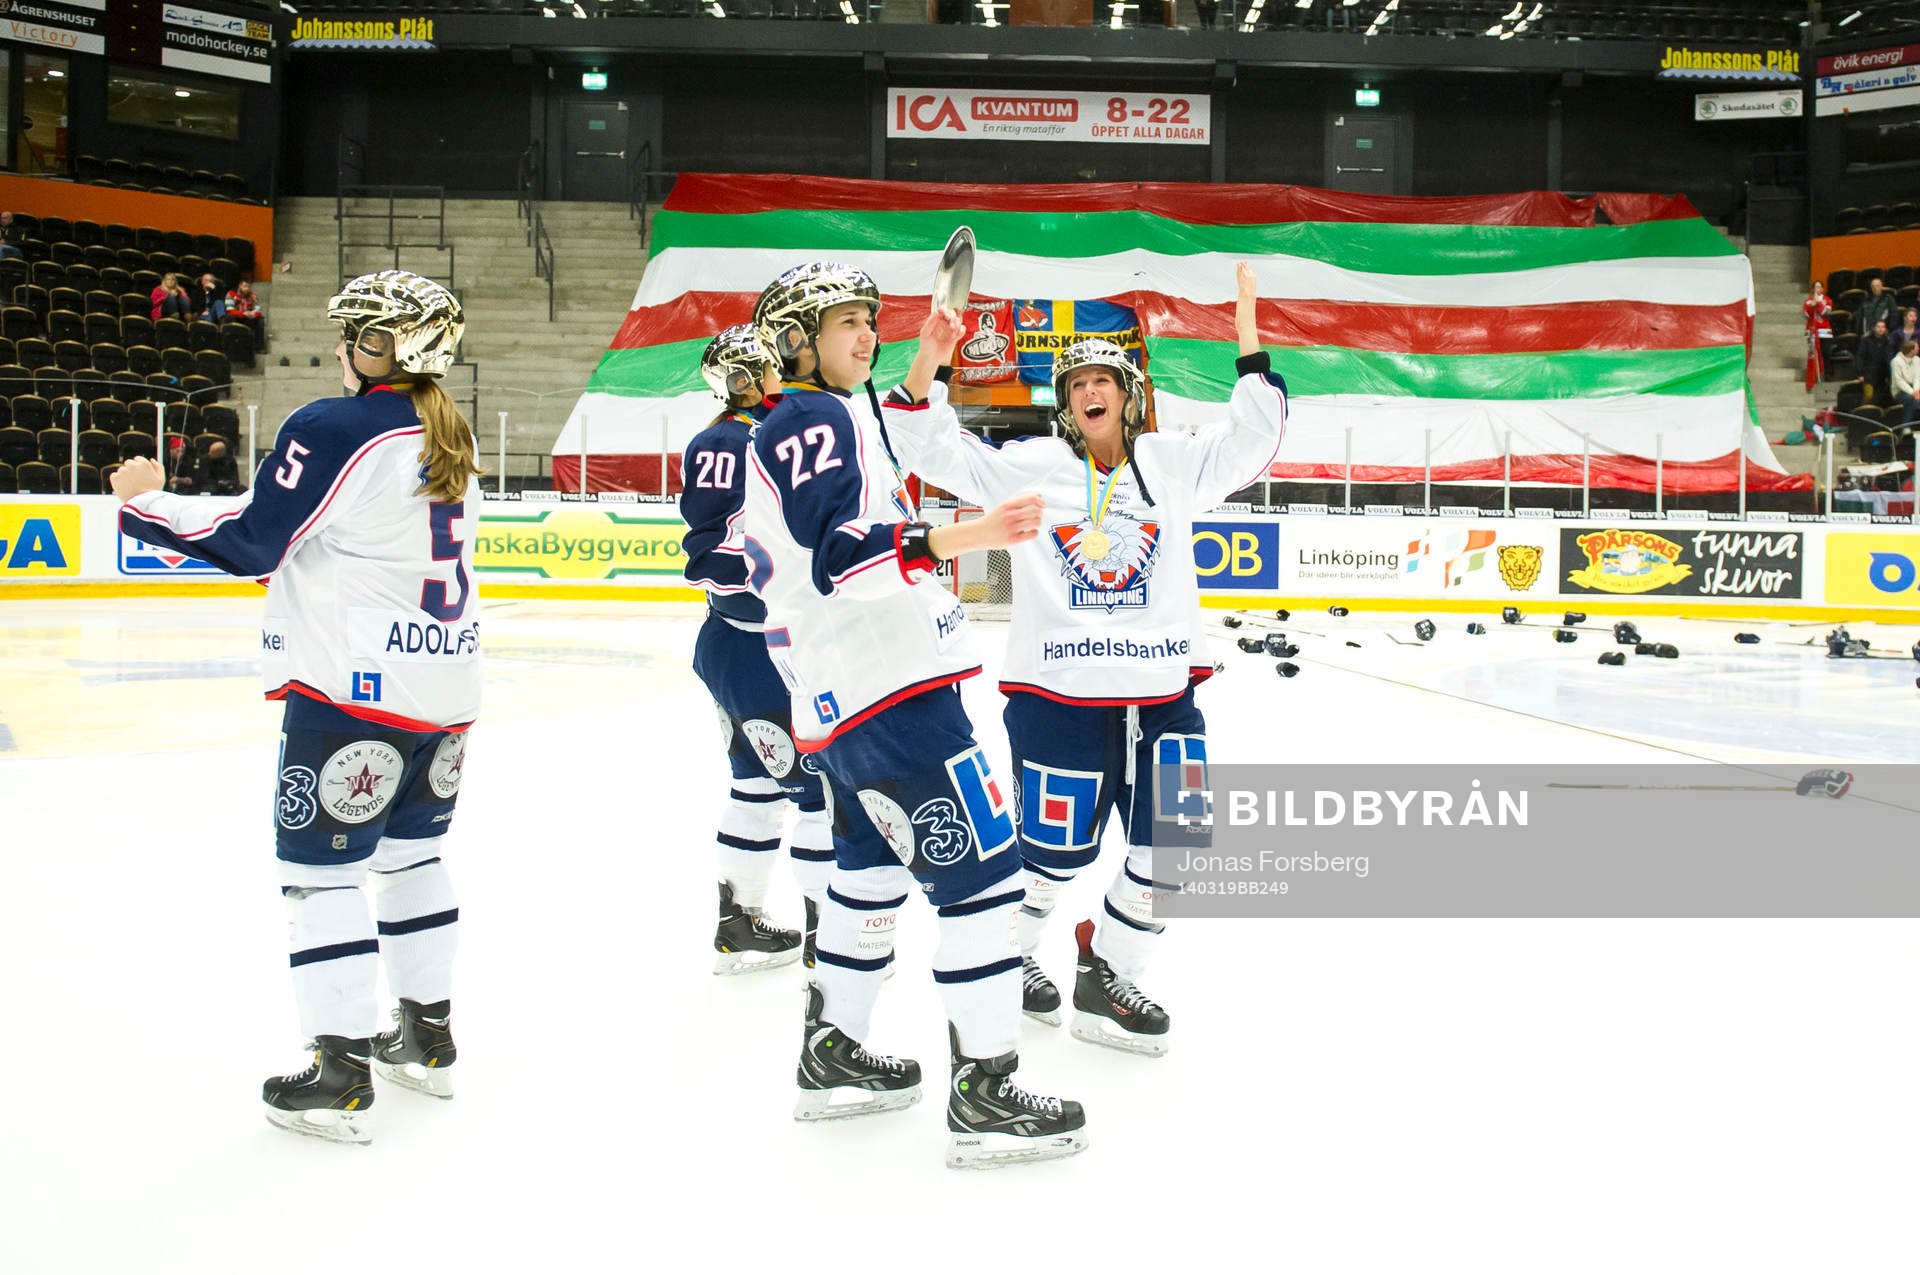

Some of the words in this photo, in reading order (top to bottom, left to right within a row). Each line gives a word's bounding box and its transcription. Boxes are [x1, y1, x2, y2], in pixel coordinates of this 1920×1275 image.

[11, 2, 96, 26] ÅGRENSHUSET
[11, 22, 78, 48] Victory
[291, 17, 395, 40] Johanssons
[400, 17, 434, 41] Plåt
[166, 31, 268, 57] modohockey.se
[1661, 47, 1762, 71] Johanssons
[1767, 49, 1799, 73] Plåt
[1833, 54, 1860, 70] övik
[1861, 48, 1904, 65] energi
[896, 95, 967, 132] ICA
[976, 102, 1074, 117] KVANTUM
[1106, 97, 1190, 124] 8-22
[995, 124, 1021, 136] riktig
[1091, 123, 1129, 138] ÖPPET
[1133, 126, 1162, 138] ALLA
[1165, 126, 1205, 140] DAGAR
[275, 439, 312, 489] 5
[775, 424, 843, 490] 22
[695, 451, 736, 489] 20
[601, 494, 635, 502] VOLVIA
[1579, 530, 1679, 566] PÄRSONS
[1692, 530, 1799, 560] tunna
[420, 501, 470, 622] 5
[1299, 549, 1399, 570] Linköping
[1700, 551, 1793, 594] skivor
[1075, 587, 1144, 606] LINKÖPING
[337, 749, 362, 768] NEW
[370, 748, 395, 765] YORK
[347, 775, 380, 792] NYL
[333, 794, 385, 817] LEGENDS
[956, 1139, 982, 1147] Reebok
